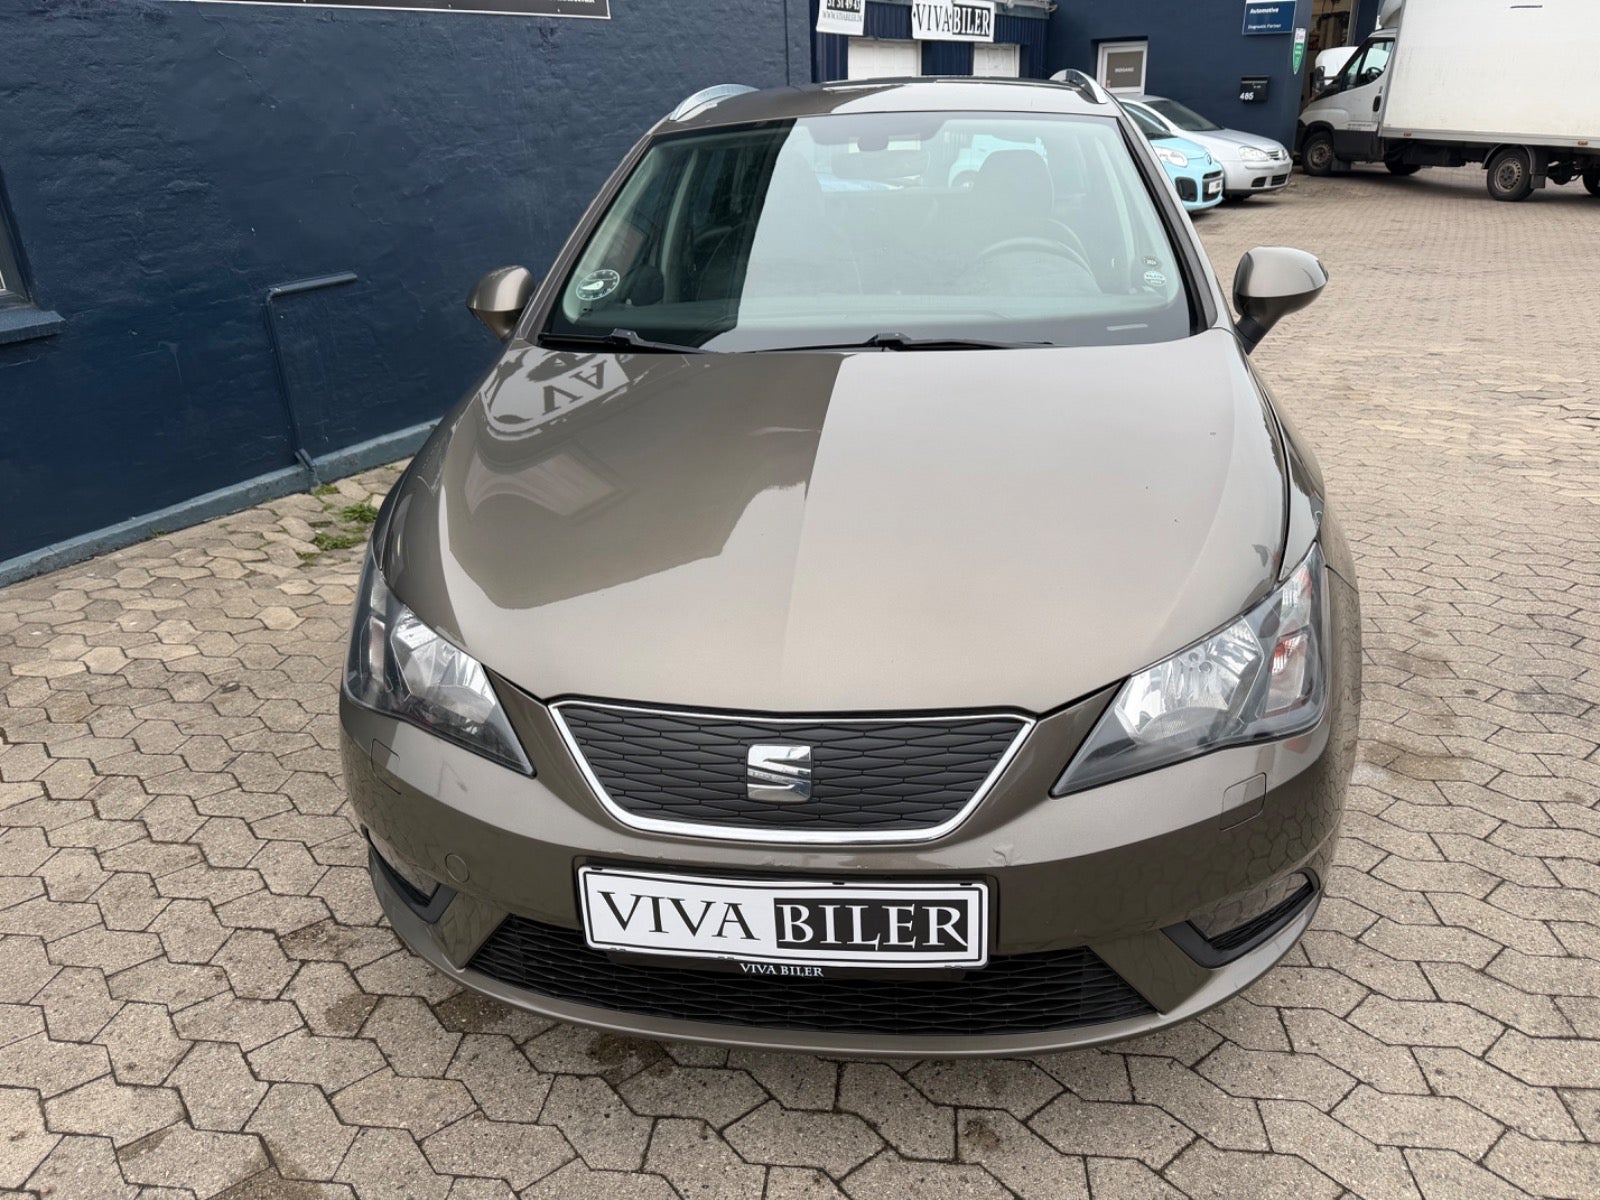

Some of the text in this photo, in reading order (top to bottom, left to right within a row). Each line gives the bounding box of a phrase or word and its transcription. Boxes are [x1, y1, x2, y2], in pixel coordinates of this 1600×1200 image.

[915, 3, 989, 35] VIVA BILER
[597, 891, 969, 951] VIVA BILER
[740, 963, 824, 977] VIVA BILER
